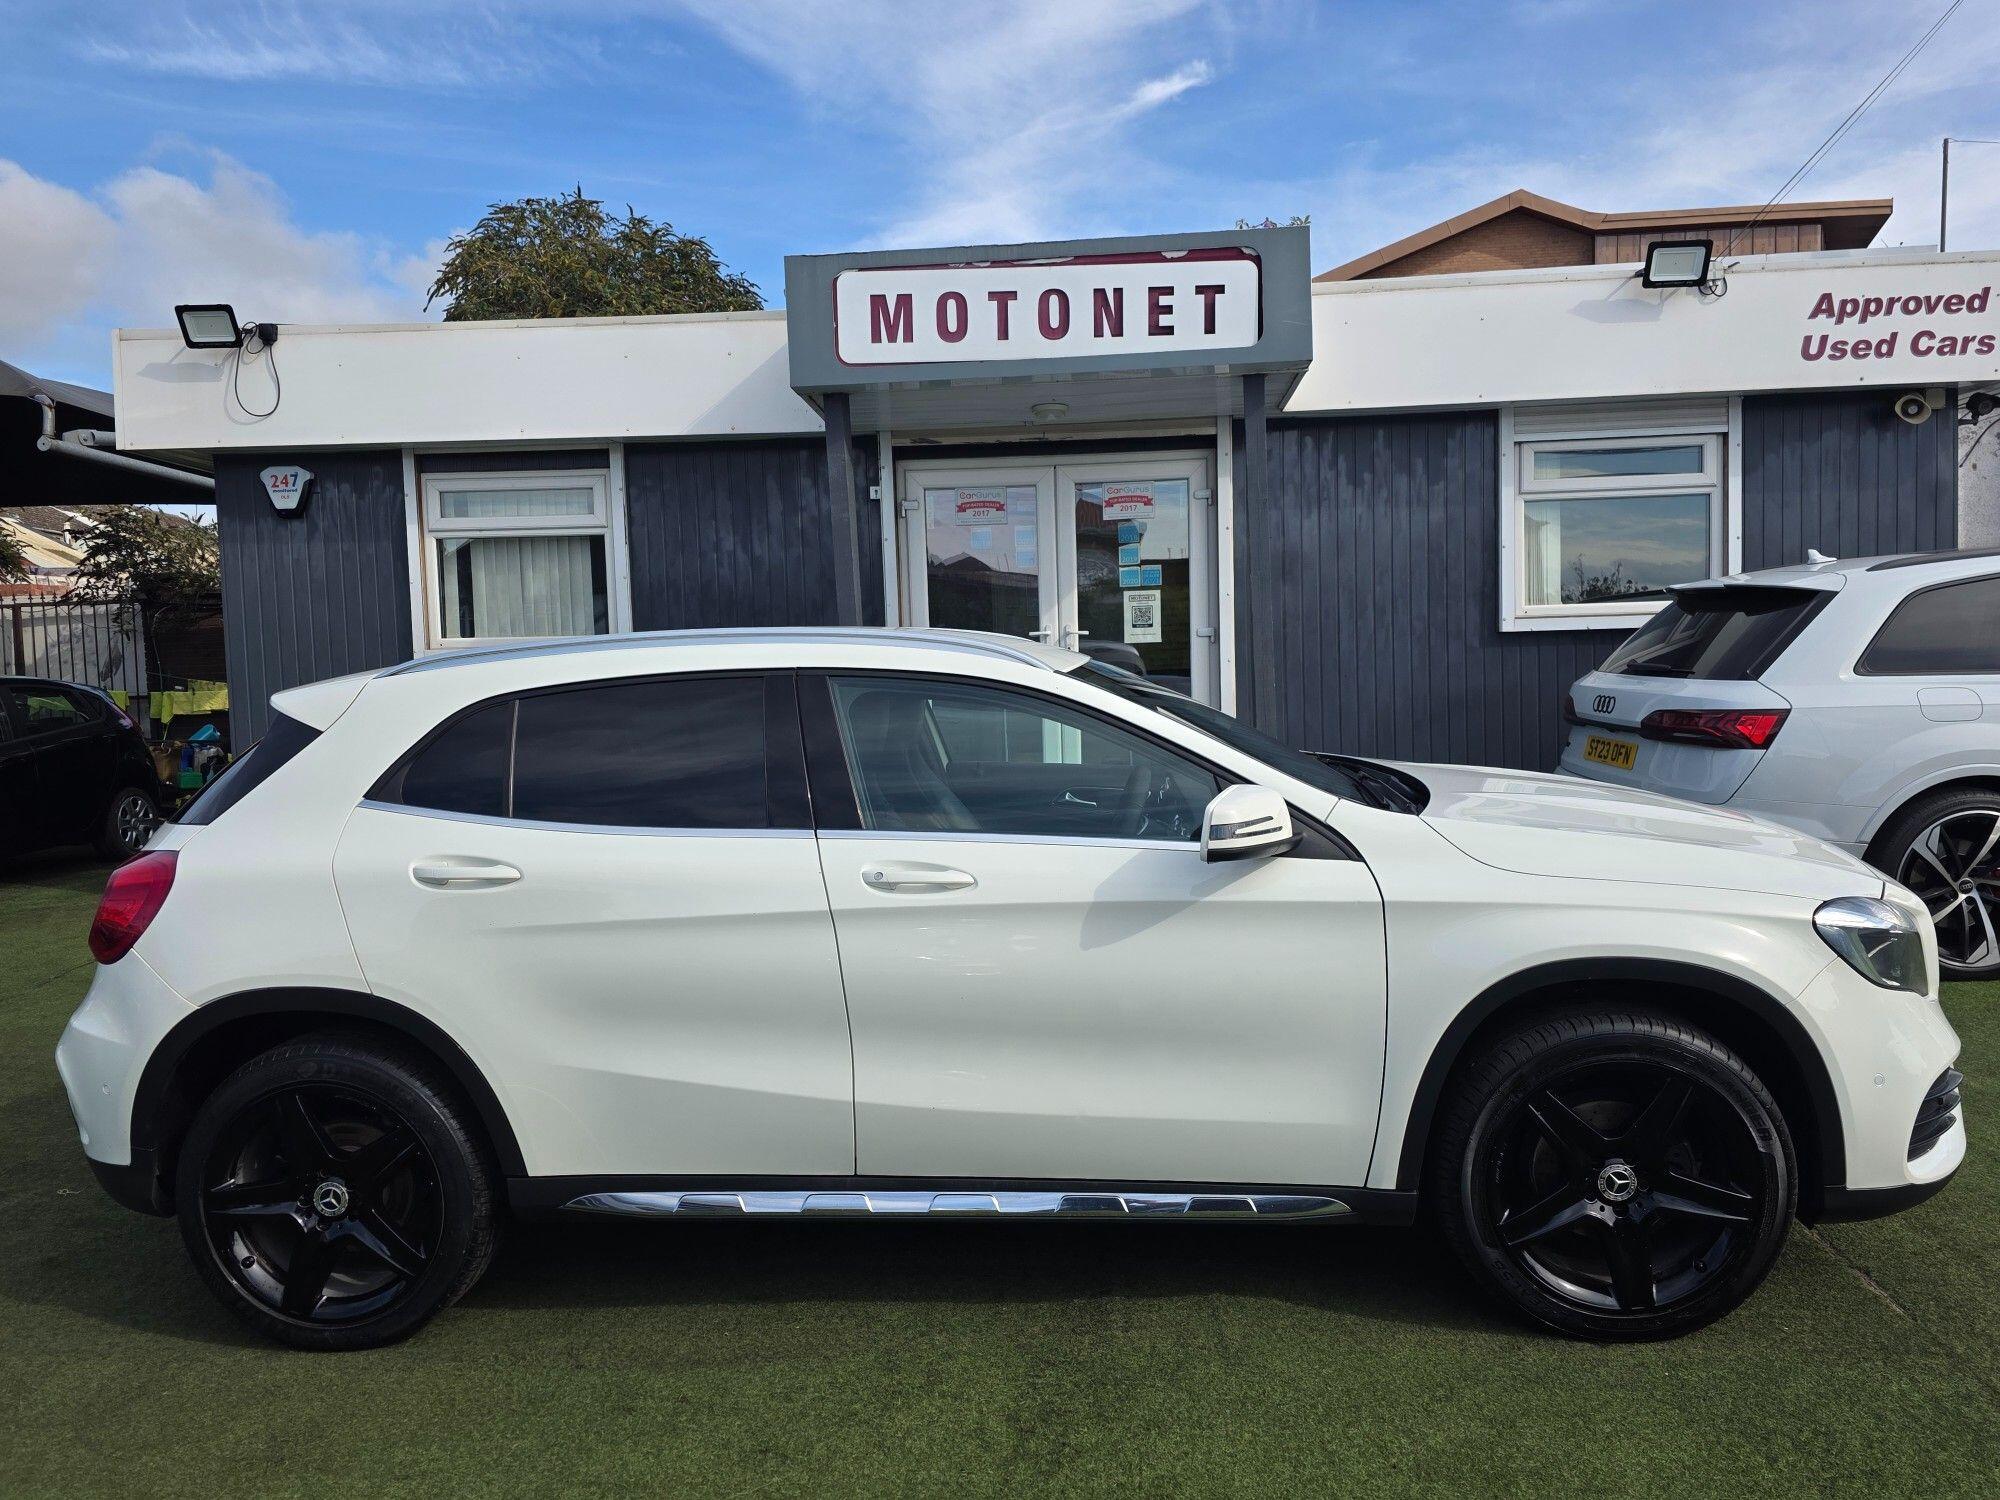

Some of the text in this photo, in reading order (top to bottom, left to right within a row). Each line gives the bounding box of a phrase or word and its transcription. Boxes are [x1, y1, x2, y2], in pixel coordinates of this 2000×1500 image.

[870, 284, 1226, 343] MOTONET
[1808, 286, 1992, 326] Approved
[1800, 330, 1996, 362] Used Cars
[270, 471, 299, 489] 247
[959, 491, 1003, 500] CarGurus
[1106, 486, 1152, 495] CarGurus
[972, 509, 990, 517] 2017
[1119, 504, 1138, 512] 2017
[1588, 738, 1633, 765] ST23 OFN
